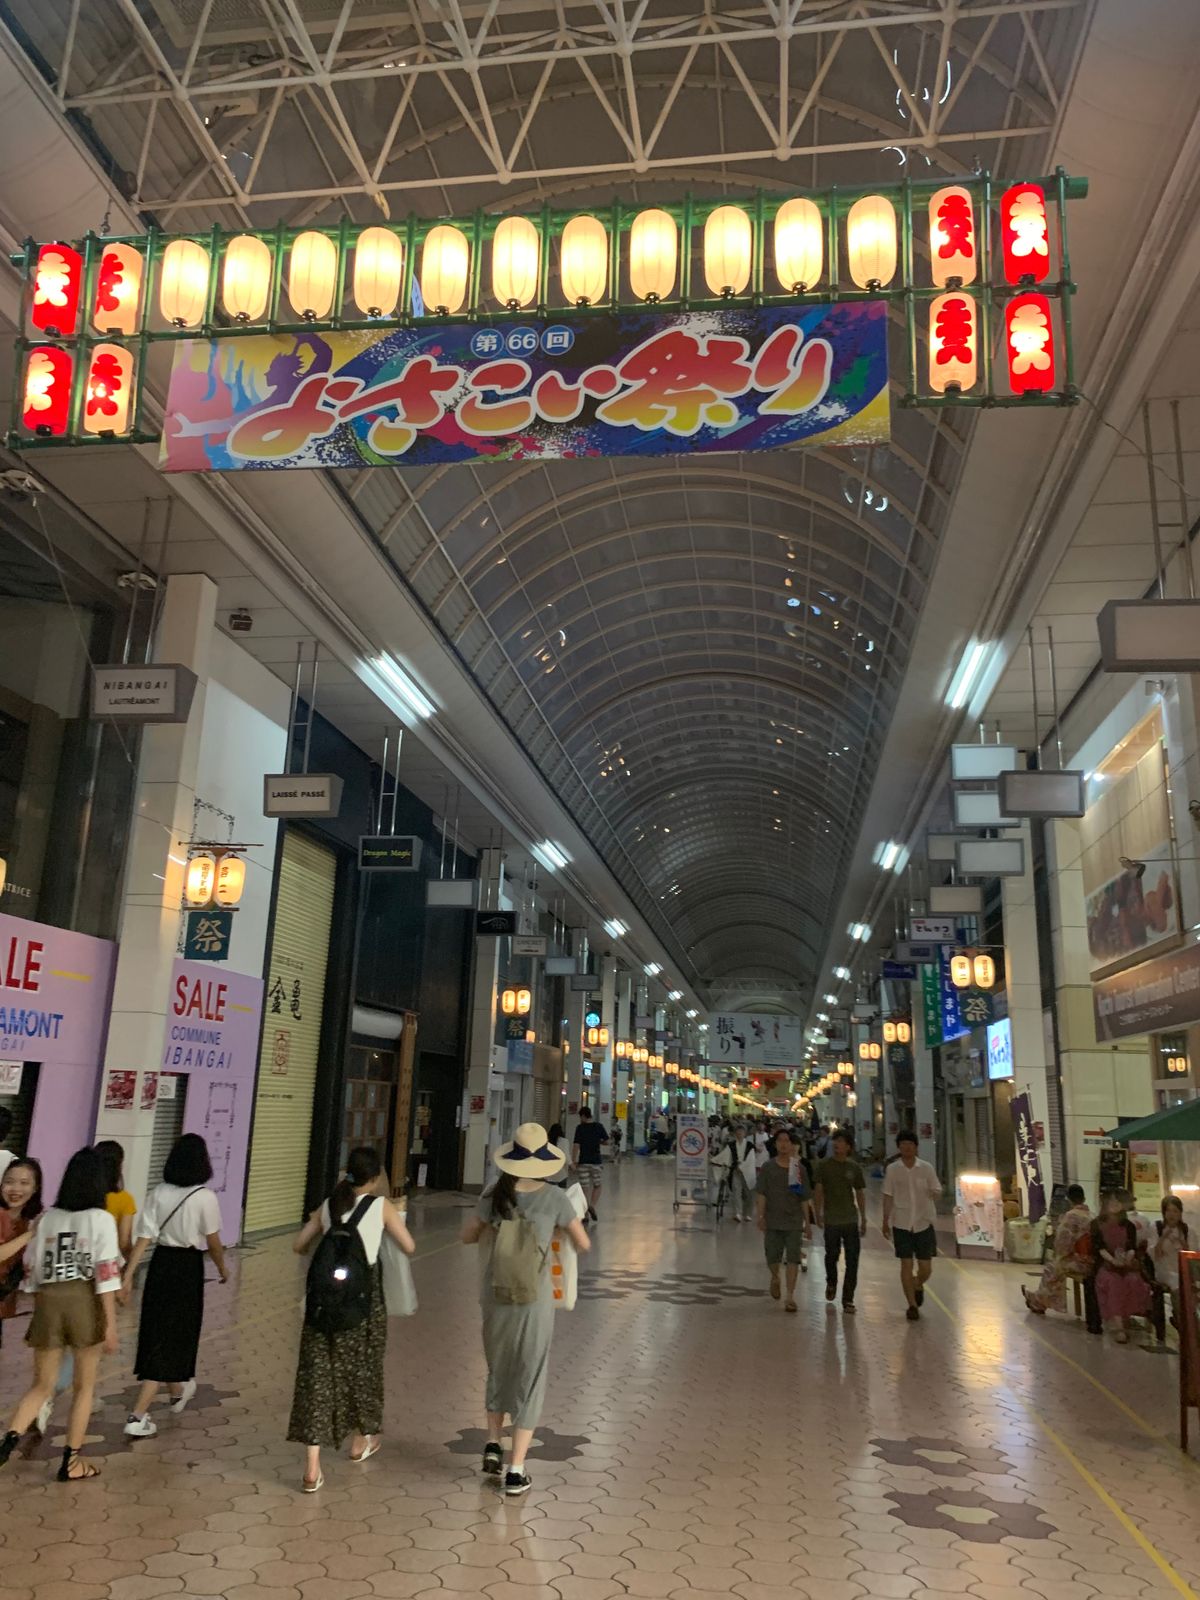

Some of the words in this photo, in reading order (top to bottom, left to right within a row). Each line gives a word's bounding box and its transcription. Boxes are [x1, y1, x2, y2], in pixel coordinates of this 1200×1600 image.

[475, 331, 570, 353] 第66回
[226, 323, 835, 460] よさこい祭り
[103, 681, 168, 690] NIBANGAI
[271, 790, 298, 798] LAISSÉ
[300, 790, 326, 798] PASSÉ
[191, 918, 228, 953] 祭
[0, 937, 44, 991] LE
[173, 974, 228, 1022] SALE
[171, 1026, 222, 1045] COMMUNE
[716, 1017, 734, 1055] 振り
